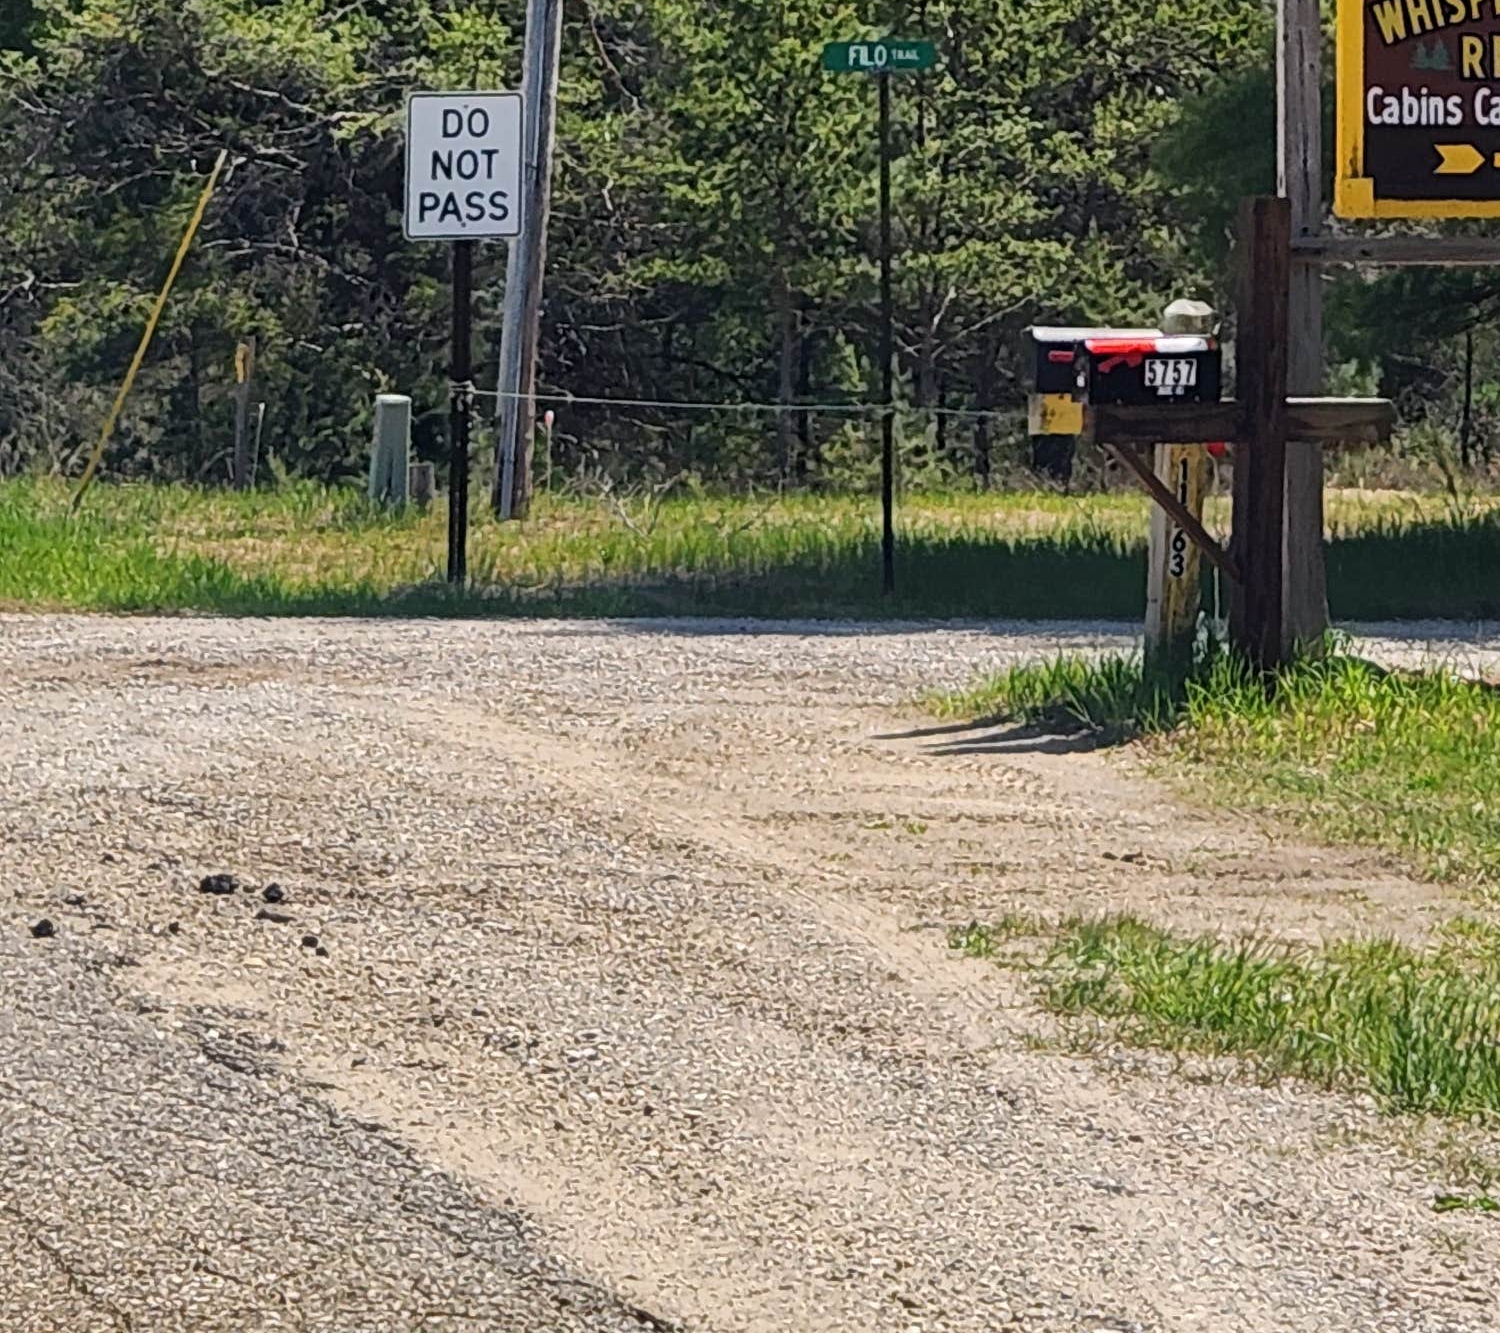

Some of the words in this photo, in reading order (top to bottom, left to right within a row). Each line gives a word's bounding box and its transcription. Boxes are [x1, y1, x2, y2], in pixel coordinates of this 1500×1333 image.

[848, 44, 888, 67] FILO
[1366, 86, 1463, 126] Cabins
[442, 108, 490, 138] DO
[431, 149, 499, 180] NOT
[418, 191, 509, 223] PASS
[1147, 359, 1194, 385] 5757
